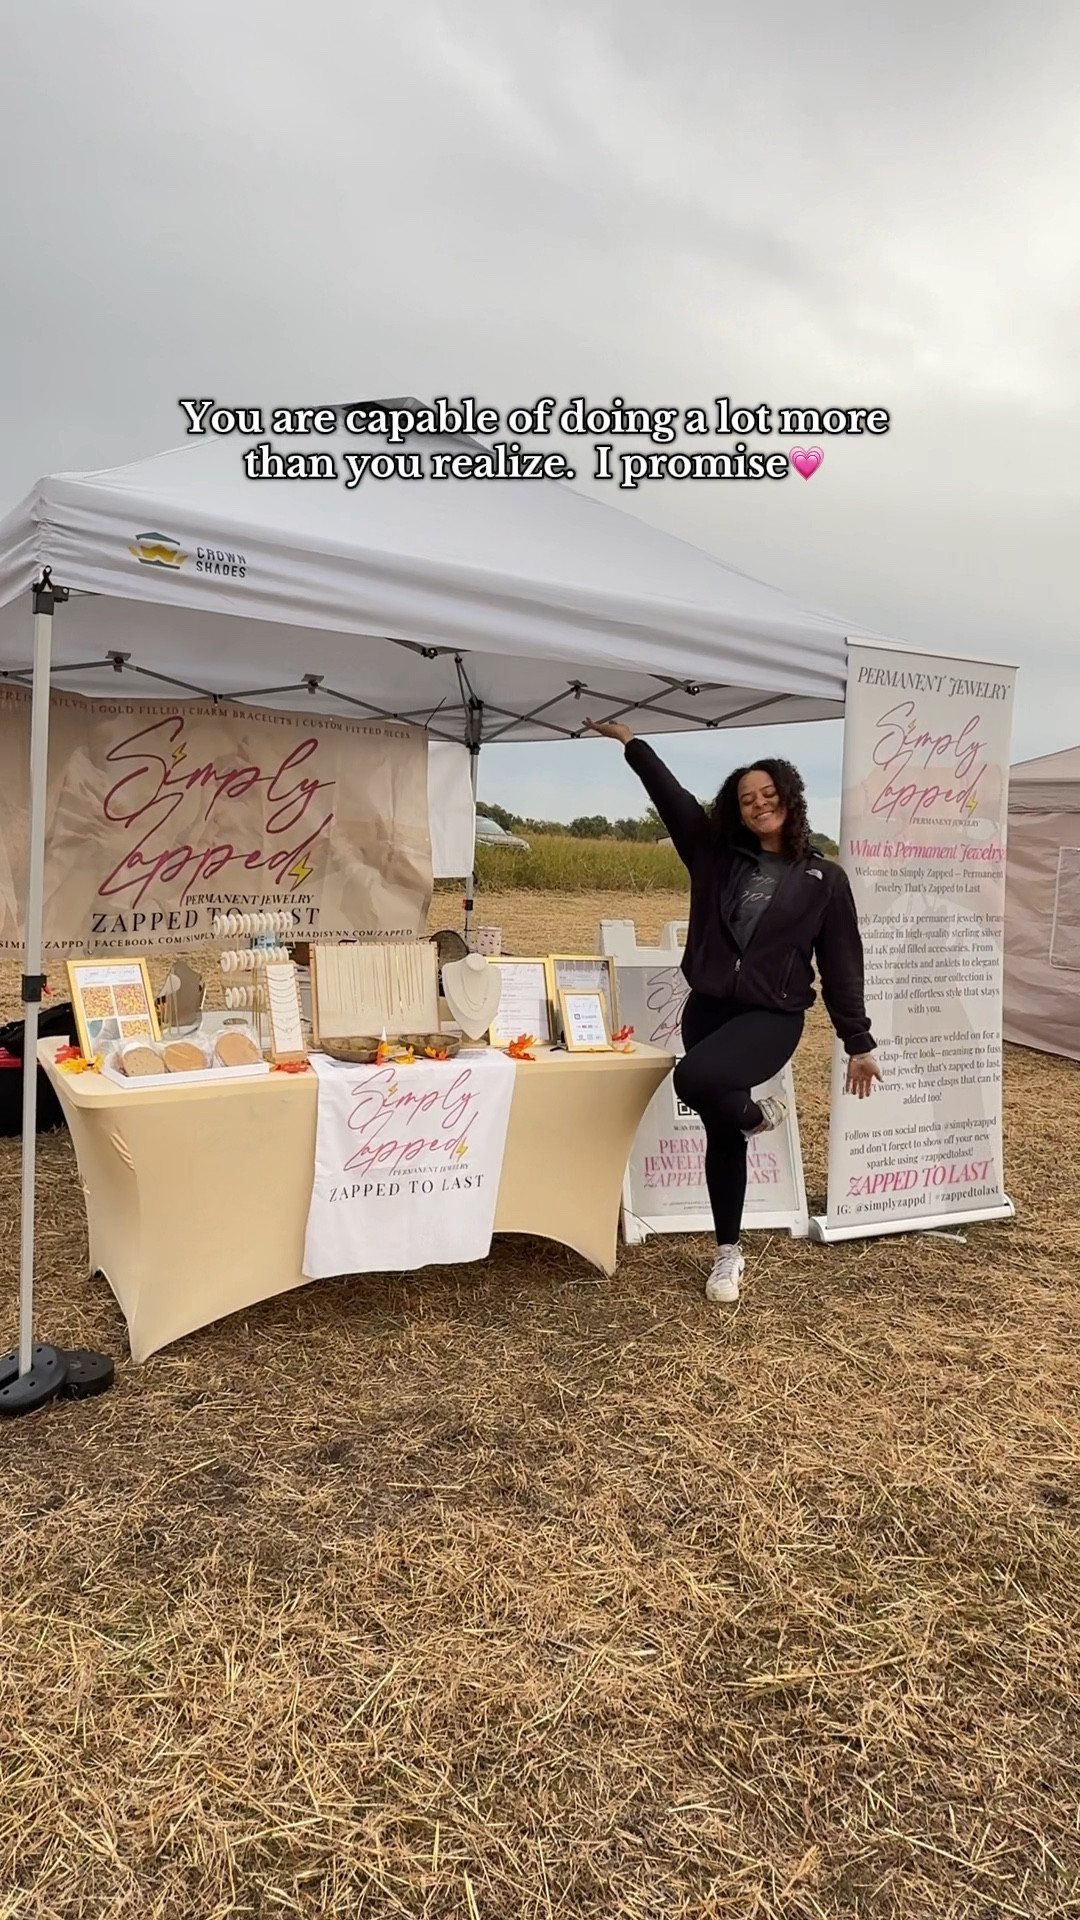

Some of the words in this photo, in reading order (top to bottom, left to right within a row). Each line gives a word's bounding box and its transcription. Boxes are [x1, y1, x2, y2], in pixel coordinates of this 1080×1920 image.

[196, 546, 247, 565] CROWN
[195, 560, 247, 578] SHADES
[857, 666, 947, 693] PERMANENT
[948, 677, 1011, 701] JEWELRY
[99, 704, 135, 715] GOLD
[189, 706, 228, 717] CHARM
[232, 710, 292, 726] BRACELETS
[302, 719, 343, 732] CUSTOM
[873, 701, 988, 779] Simply
[103, 715, 337, 834] Simply
[871, 750, 988, 823] Zapped
[912, 816, 952, 827] PERMANENT
[98, 792, 335, 908] Zapped
[850, 839, 881, 857] What
[883, 840, 893, 858] is
[894, 841, 958, 859] Permanent
[855, 866, 889, 877] Welcome
[890, 868, 898, 877] to
[899, 867, 924, 879] Simply
[926, 868, 954, 880] Zapped
[963, 868, 1004, 879] Permanent
[874, 882, 902, 894] Jewelry
[904, 882, 927, 893] That's
[927, 883, 955, 895] Zapped
[956, 884, 964, 893] to
[965, 884, 981, 893] Last
[185, 892, 260, 907] PERMANENT
[260, 892, 316, 906] JEWELRY
[92, 909, 199, 933] ZAPPED
[872, 913, 901, 925] Zapped
[902, 913, 909, 923] is
[909, 915, 914, 923] a
[916, 913, 956, 925] permanent
[956, 913, 983, 924] jewelry
[896, 928, 904, 938] in
[905, 928, 949, 939] high-quality
[952, 928, 980, 938] sterling
[981, 928, 1002, 938] silver
[889, 943, 906, 956] gold
[907, 943, 926, 954] filled
[972, 943, 994, 953] From
[884, 958, 918, 970] bracelets
[919, 958, 934, 969] and
[935, 957, 961, 969] anklets
[962, 958, 970, 967] to
[971, 957, 1000, 968] elegant
[864, 975, 894, 985] ecklaces
[895, 974, 910, 985] and
[934, 975, 947, 983] our
[948, 971, 984, 982] collection
[986, 971, 993, 981] is
[884, 990, 893, 1000] to
[894, 988, 908, 1000] add
[909, 987, 945, 999] effortless
[946, 986, 962, 998] style
[963, 986, 979, 997] that
[980, 987, 1000, 998] stays
[907, 1003, 925, 1014] with
[904, 1034, 928, 1046] pieces
[929, 1034, 941, 1043] are
[943, 1031, 970, 1042] welded
[970, 1032, 981, 1041] on
[982, 1030, 994, 1040] for
[879, 1049, 918, 1062] clasp-free
[974, 1047, 985, 1055] no
[882, 1066, 896, 1077] just
[897, 1064, 925, 1077] jewelry
[927, 1062, 947, 1073] that's
[948, 1060, 975, 1073] zapped
[976, 1060, 985, 1069] to
[905, 1082, 917, 1090] we
[918, 1079, 936, 1089] have
[936, 1076, 960, 1088] clasps
[960, 1074, 976, 1085] that
[977, 1075, 991, 1084] can
[992, 1072, 1001, 1083] be
[347, 1067, 481, 1129] Simply
[903, 1093, 926, 1105] added
[844, 1130, 870, 1141] Follow
[871, 1130, 882, 1139] us
[882, 1127, 894, 1137] on
[895, 1123, 917, 1135] social
[918, 1121, 942, 1134] media
[343, 1109, 479, 1177] Zapped
[849, 1143, 865, 1156] and
[866, 1141, 887, 1154] don't
[888, 1140, 912, 1153] forget
[913, 1139, 922, 1149] to
[923, 1137, 942, 1147] show
[943, 1134, 955, 1145] off
[955, 1134, 973, 1145] your
[974, 1132, 990, 1142] new
[866, 1156, 896, 1170] sparkle
[897, 1154, 919, 1165] using
[393, 1166, 439, 1177] PERMANENT
[846, 1169, 919, 1197] ZAPPED
[921, 1164, 946, 1188] TO
[947, 1157, 995, 1184] LAST
[329, 1182, 400, 1203] ZAPPED
[408, 1180, 434, 1195] TO
[441, 1174, 485, 1192] LAST
[836, 1203, 852, 1216] IG:
